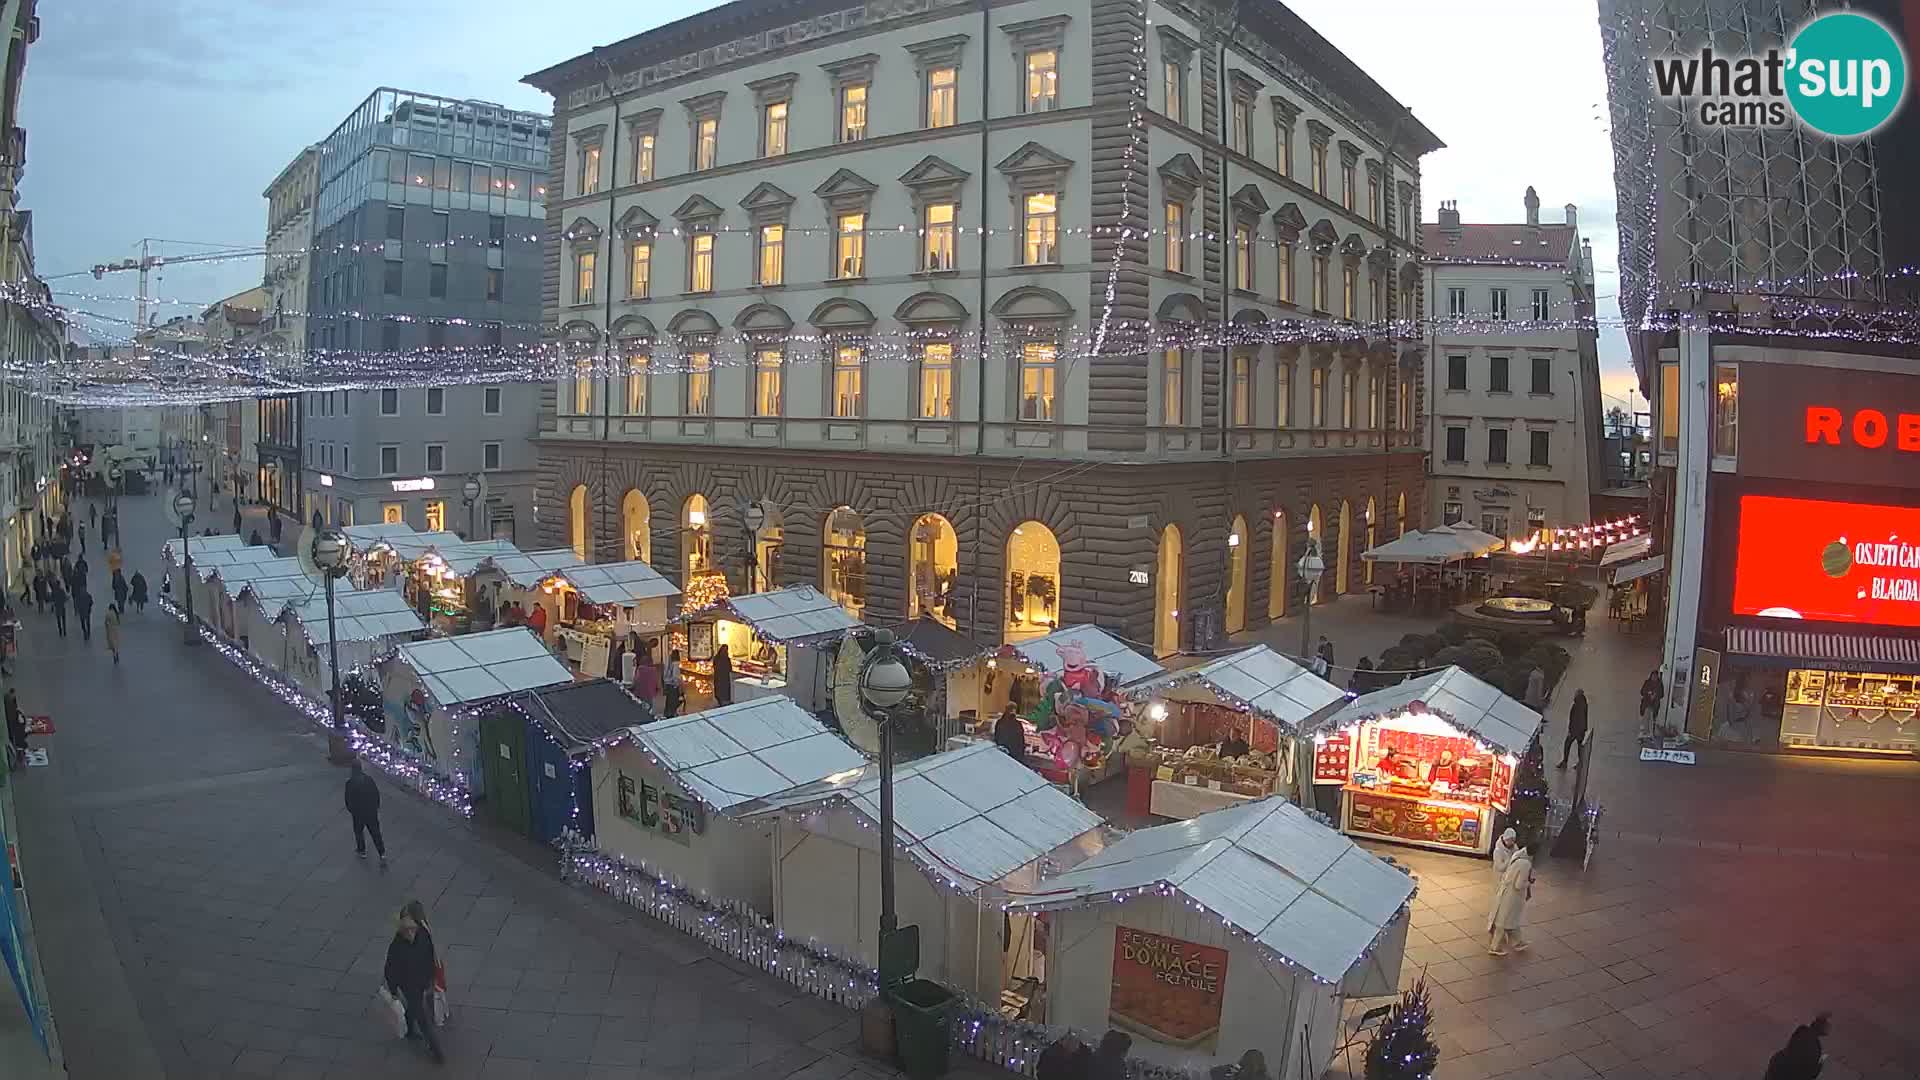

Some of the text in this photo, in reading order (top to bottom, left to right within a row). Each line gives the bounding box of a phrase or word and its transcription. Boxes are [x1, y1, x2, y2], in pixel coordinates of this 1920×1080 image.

[1855, 542, 1898, 567] OSJETI
[1123, 943, 1220, 980] DOMAĆE
[1156, 970, 1217, 993] FRITULE
